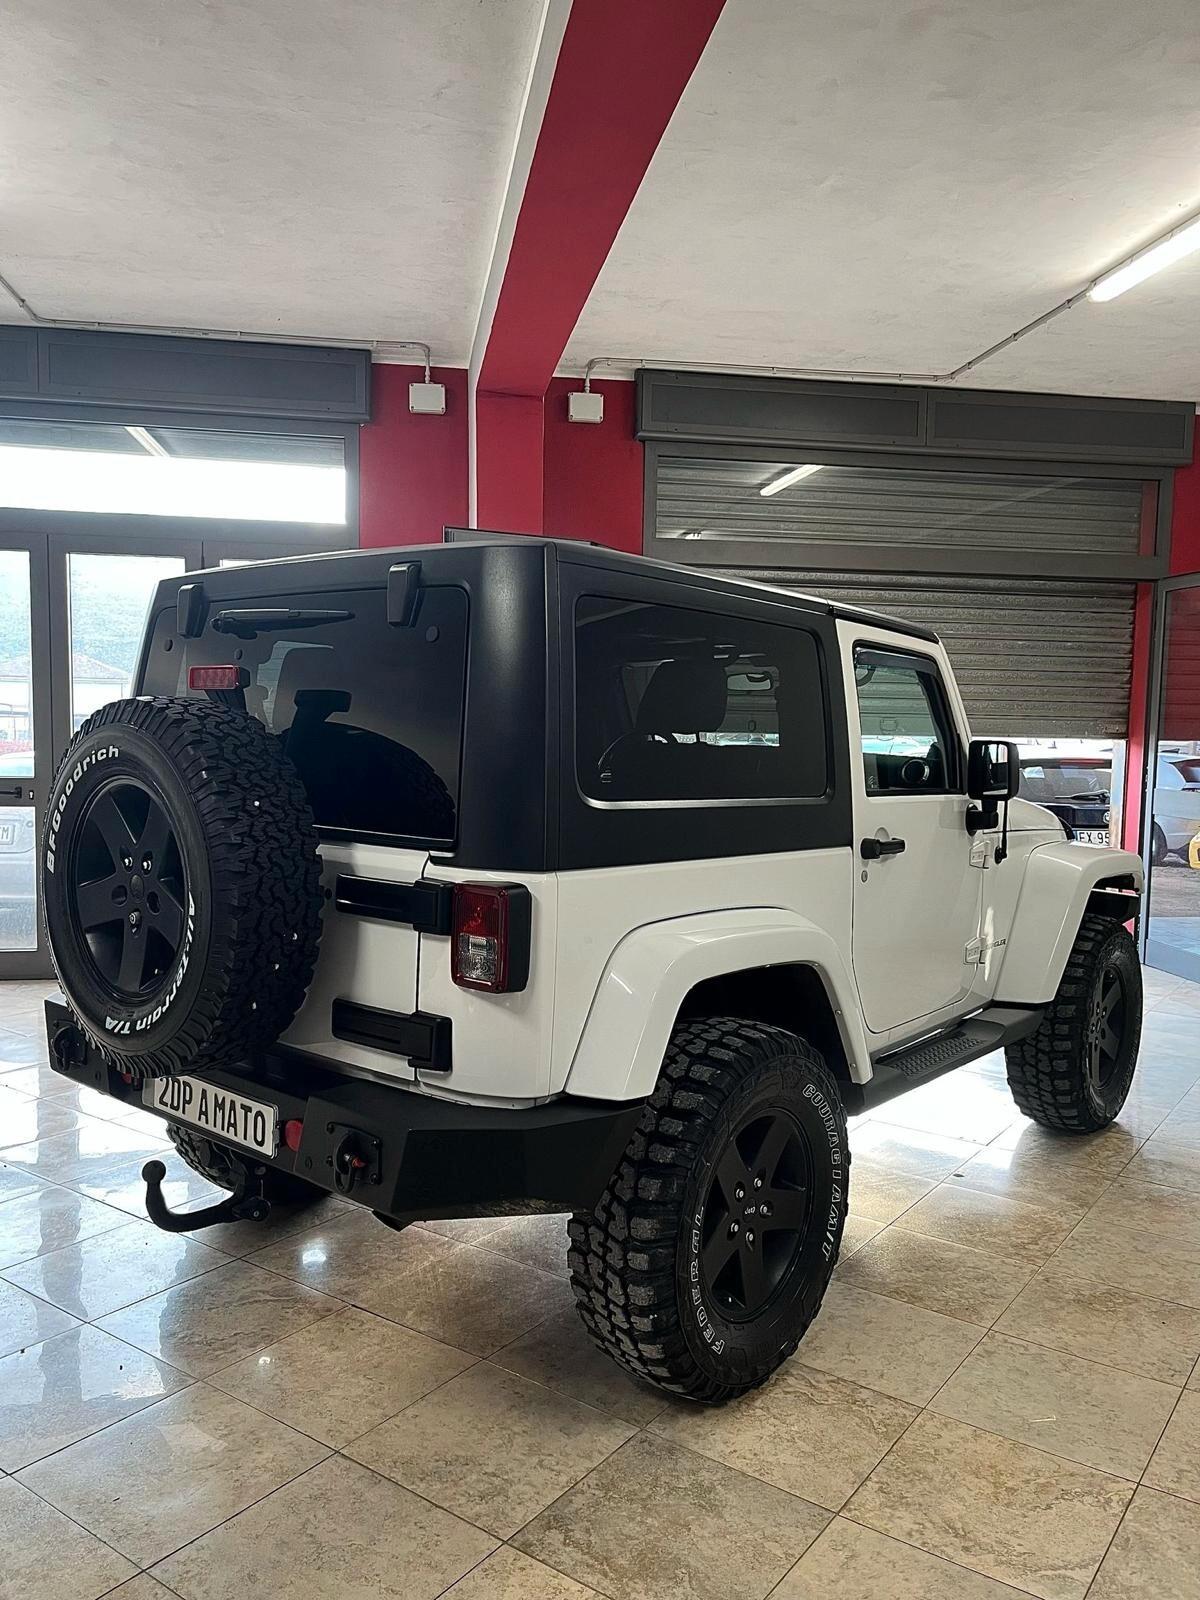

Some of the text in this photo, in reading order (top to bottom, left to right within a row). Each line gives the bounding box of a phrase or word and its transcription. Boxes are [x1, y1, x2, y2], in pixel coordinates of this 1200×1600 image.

[46, 745, 120, 875] BFGoodrich
[105, 1015, 131, 1035] T/A
[802, 1083, 842, 1203] COURAGIA
[690, 1206, 726, 1356] FEDERAL
